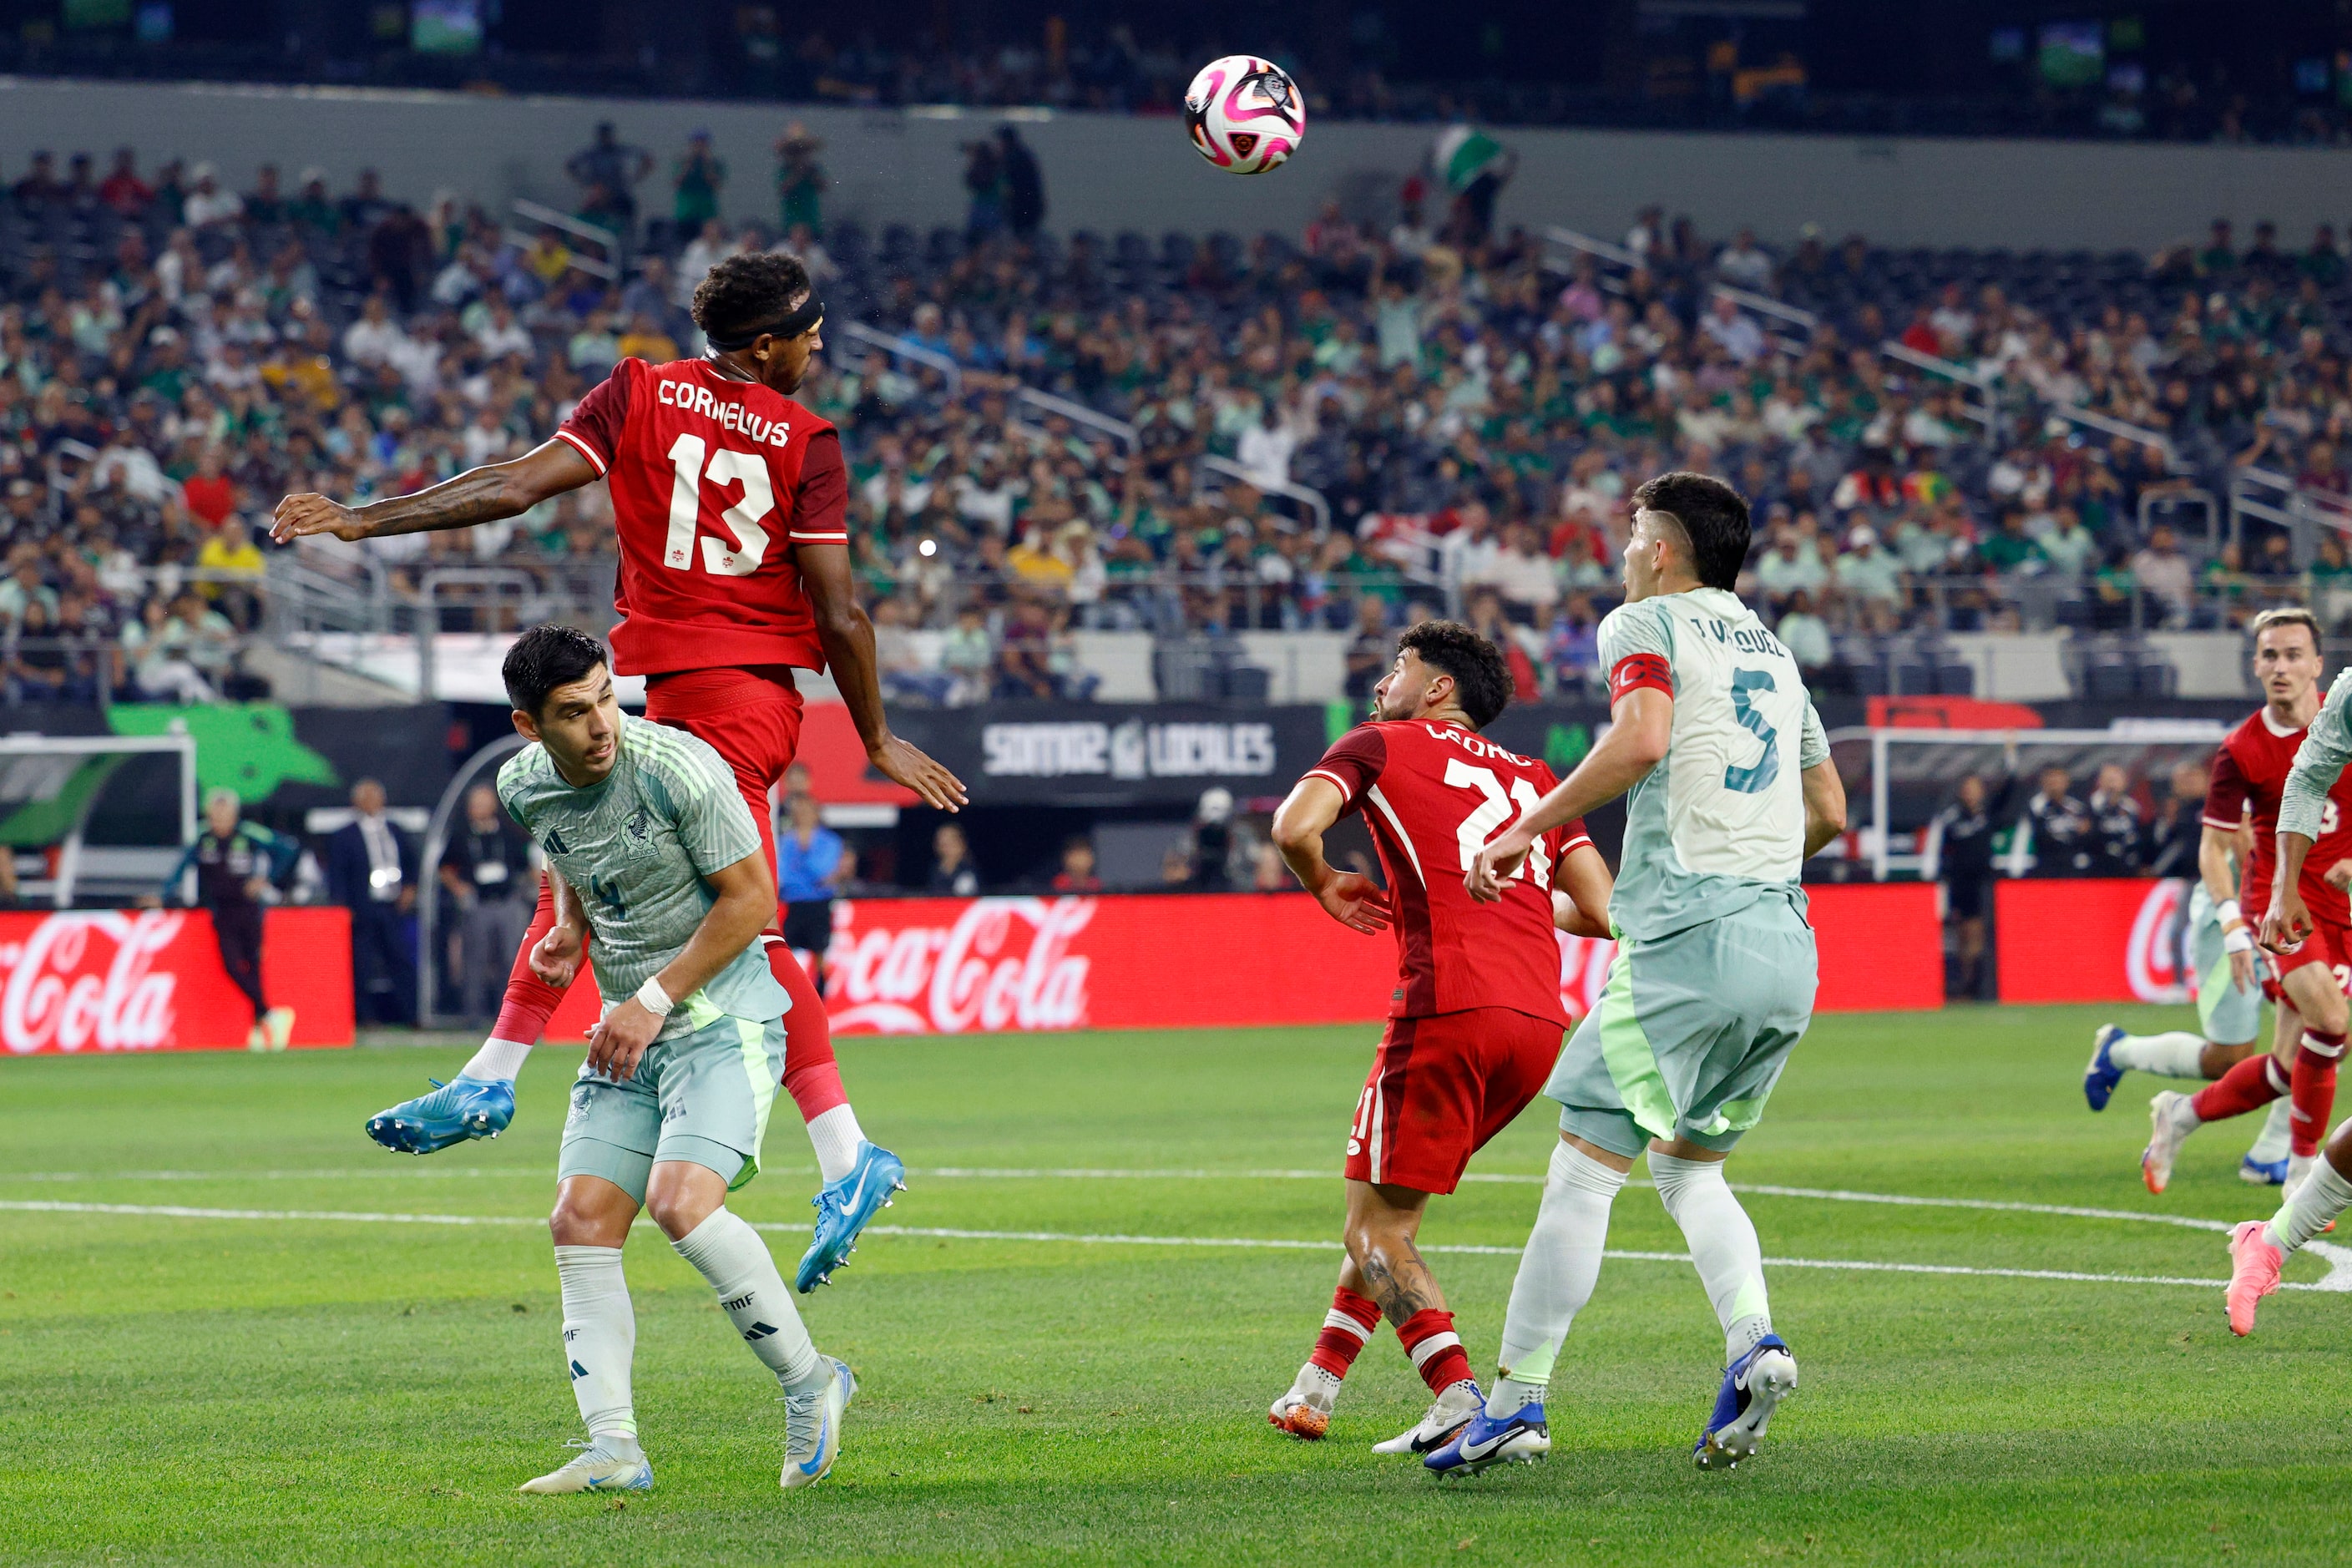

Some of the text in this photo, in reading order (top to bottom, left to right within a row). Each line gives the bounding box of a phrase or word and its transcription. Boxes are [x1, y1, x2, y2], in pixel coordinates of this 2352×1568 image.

[658, 379, 791, 448] CORNELIUS
[664, 432, 775, 576] 13
[1723, 667, 1780, 794] 5
[591, 874, 625, 922] 4
[563, 1328, 580, 1344] MF
